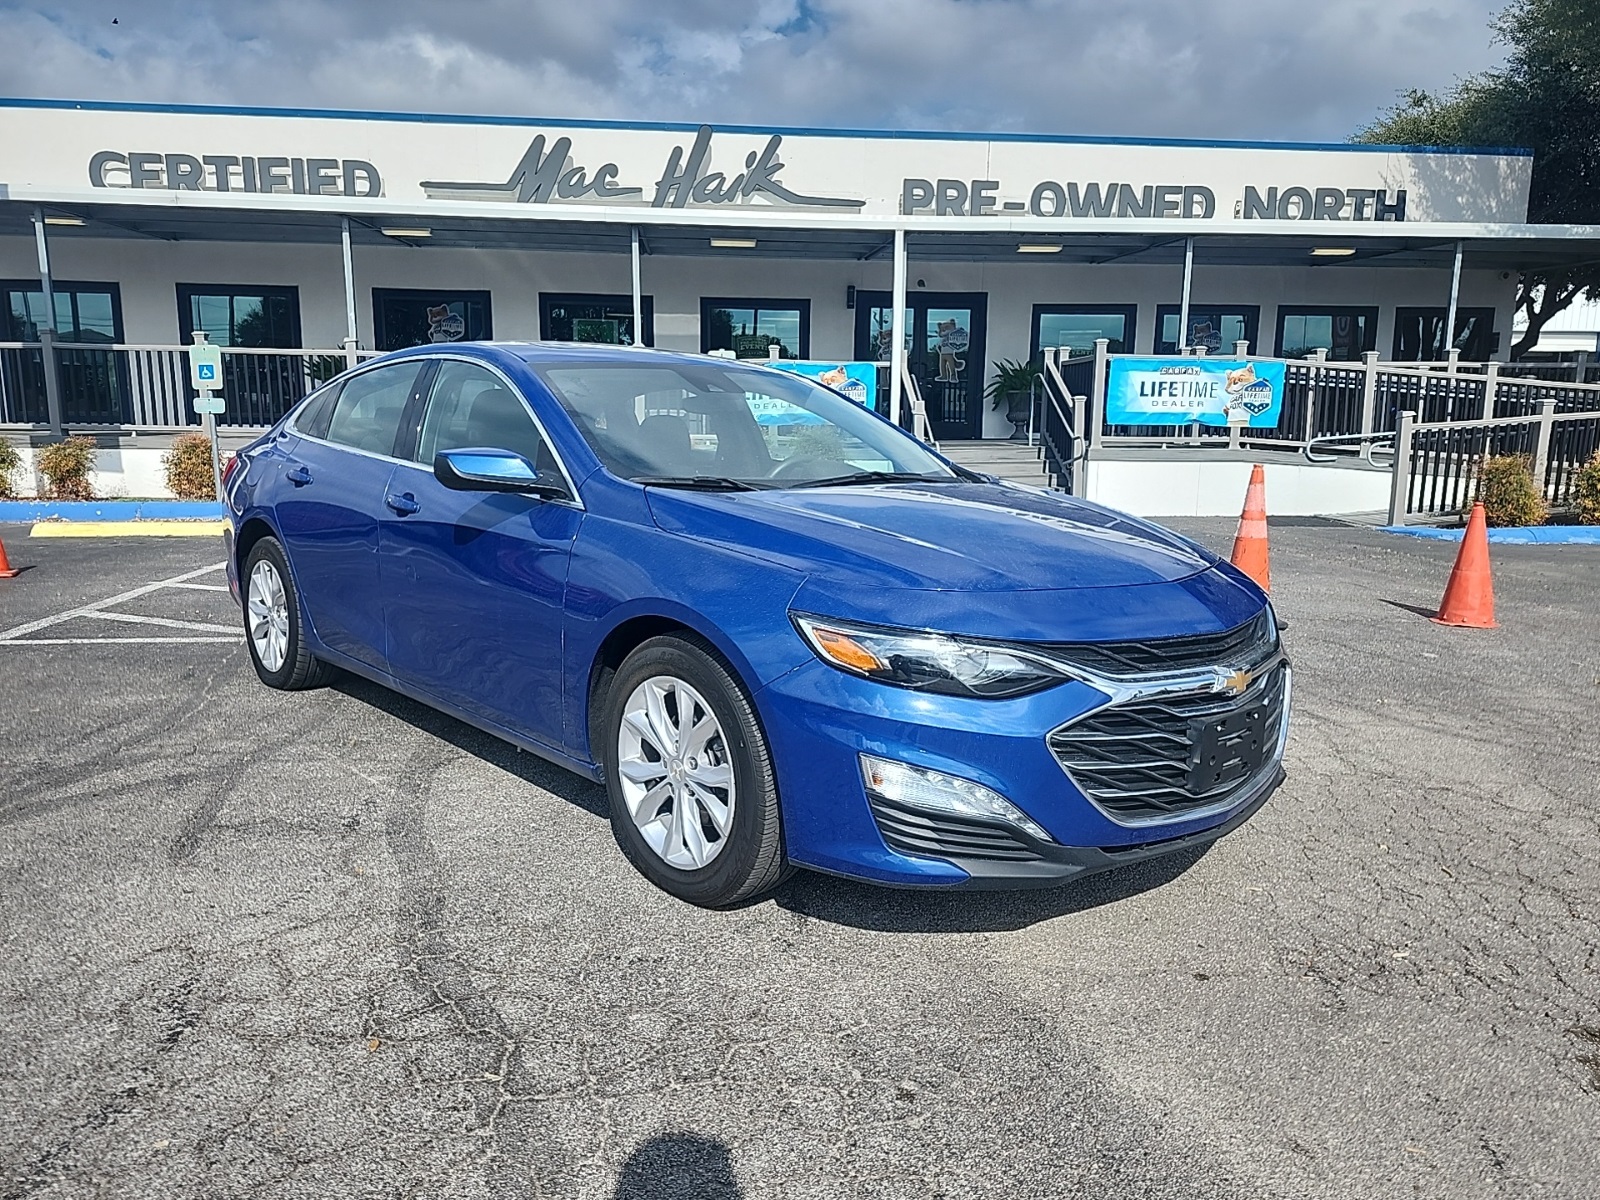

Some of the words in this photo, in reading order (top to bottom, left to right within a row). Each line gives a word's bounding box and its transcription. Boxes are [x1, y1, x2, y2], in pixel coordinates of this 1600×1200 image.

[88, 150, 382, 198] CERTIFIED
[420, 134, 642, 203] Mac
[651, 124, 867, 208] Haik
[902, 178, 1215, 218] PRE-OWNED
[1242, 185, 1408, 221] NORTH
[1160, 367, 1201, 376] CARFAX
[1140, 381, 1219, 399] LIFETIME
[1152, 400, 1204, 408] DEALER
